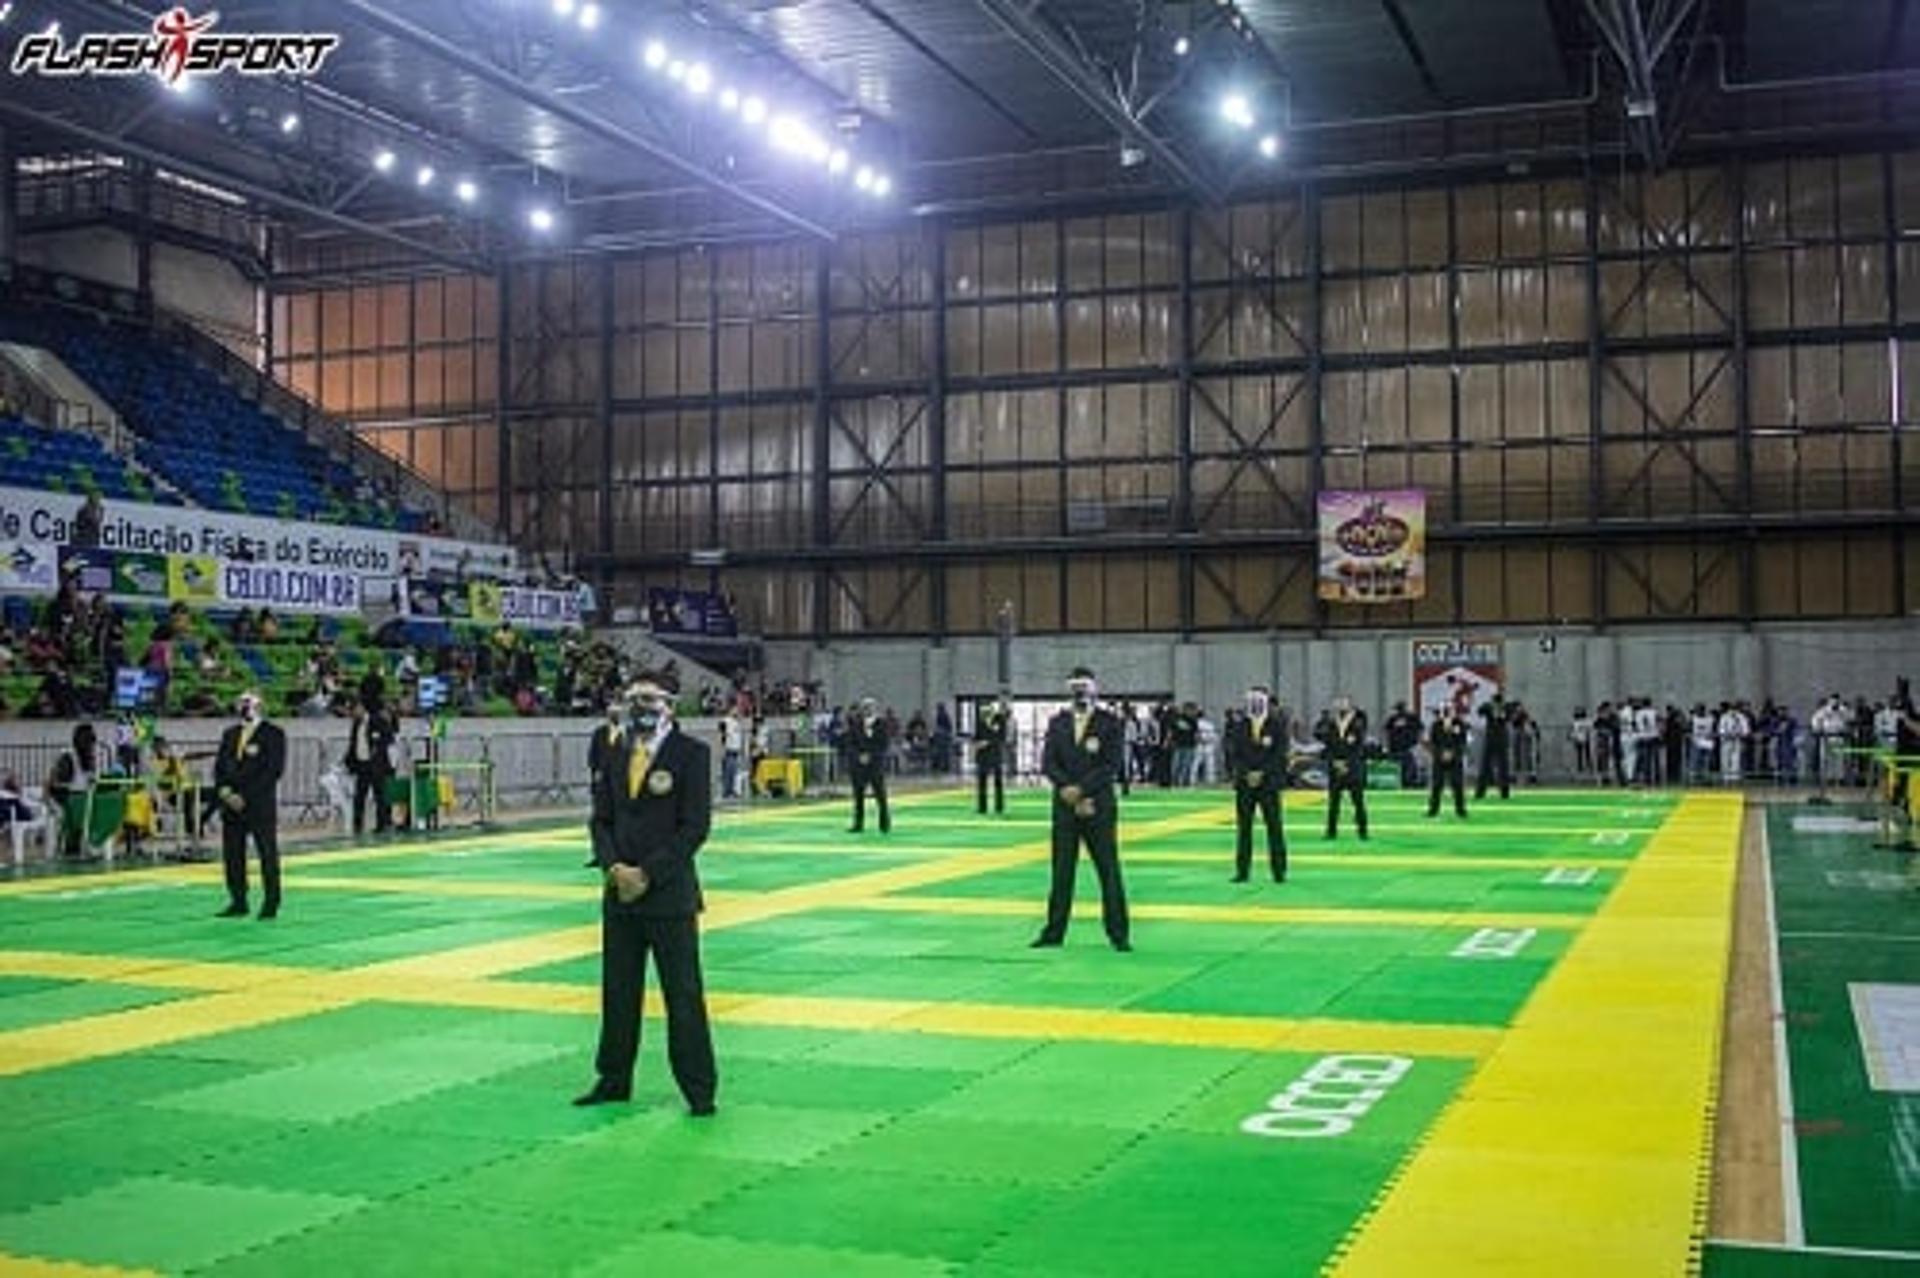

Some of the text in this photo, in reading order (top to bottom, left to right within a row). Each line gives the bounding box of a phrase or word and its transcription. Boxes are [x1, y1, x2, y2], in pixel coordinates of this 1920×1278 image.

[30, 509, 194, 554] Cacitação
[275, 534, 300, 562] do
[309, 536, 389, 570] Exército
